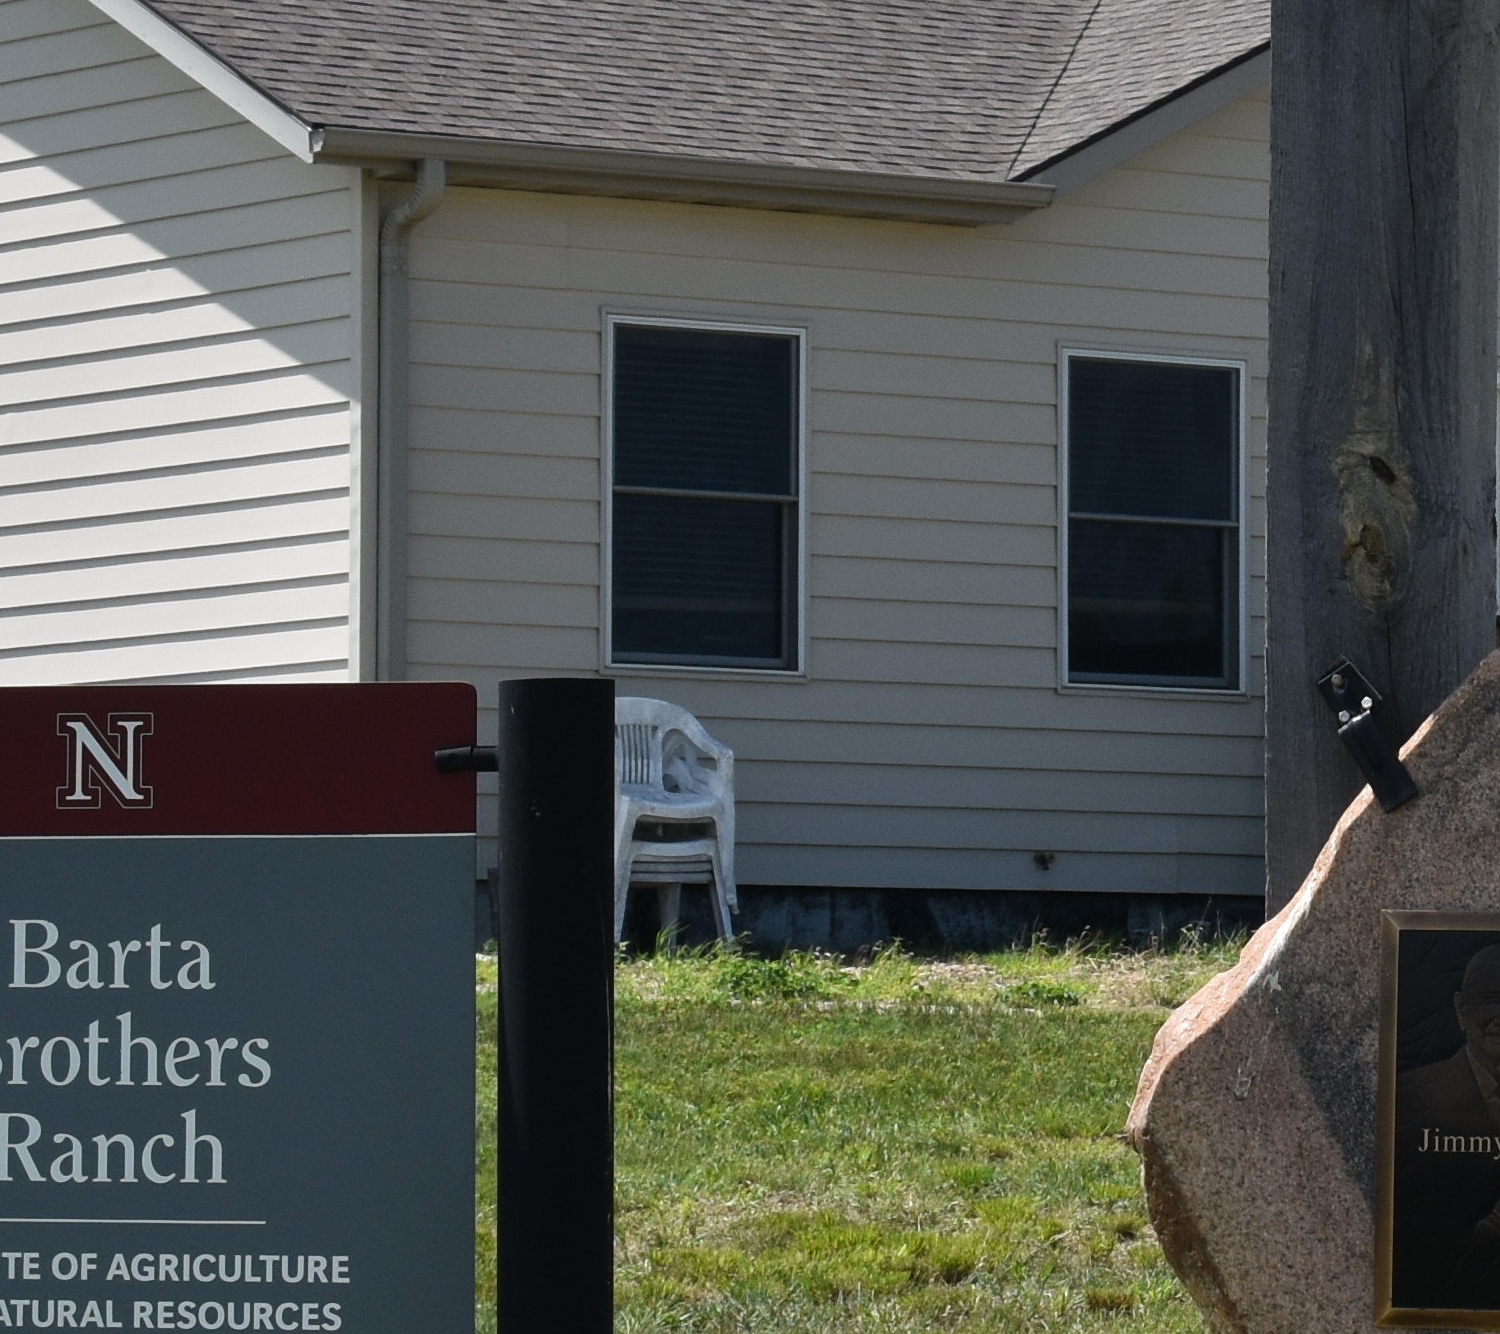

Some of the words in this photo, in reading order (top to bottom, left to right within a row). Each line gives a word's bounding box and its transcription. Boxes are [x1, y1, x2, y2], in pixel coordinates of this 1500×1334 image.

[56, 712, 154, 809] N
[8, 919, 216, 990] Barta
[51, 1252, 98, 1281] OF
[105, 1252, 351, 1284] AGRICULTURE
[133, 1300, 342, 1331] RESOURCES
